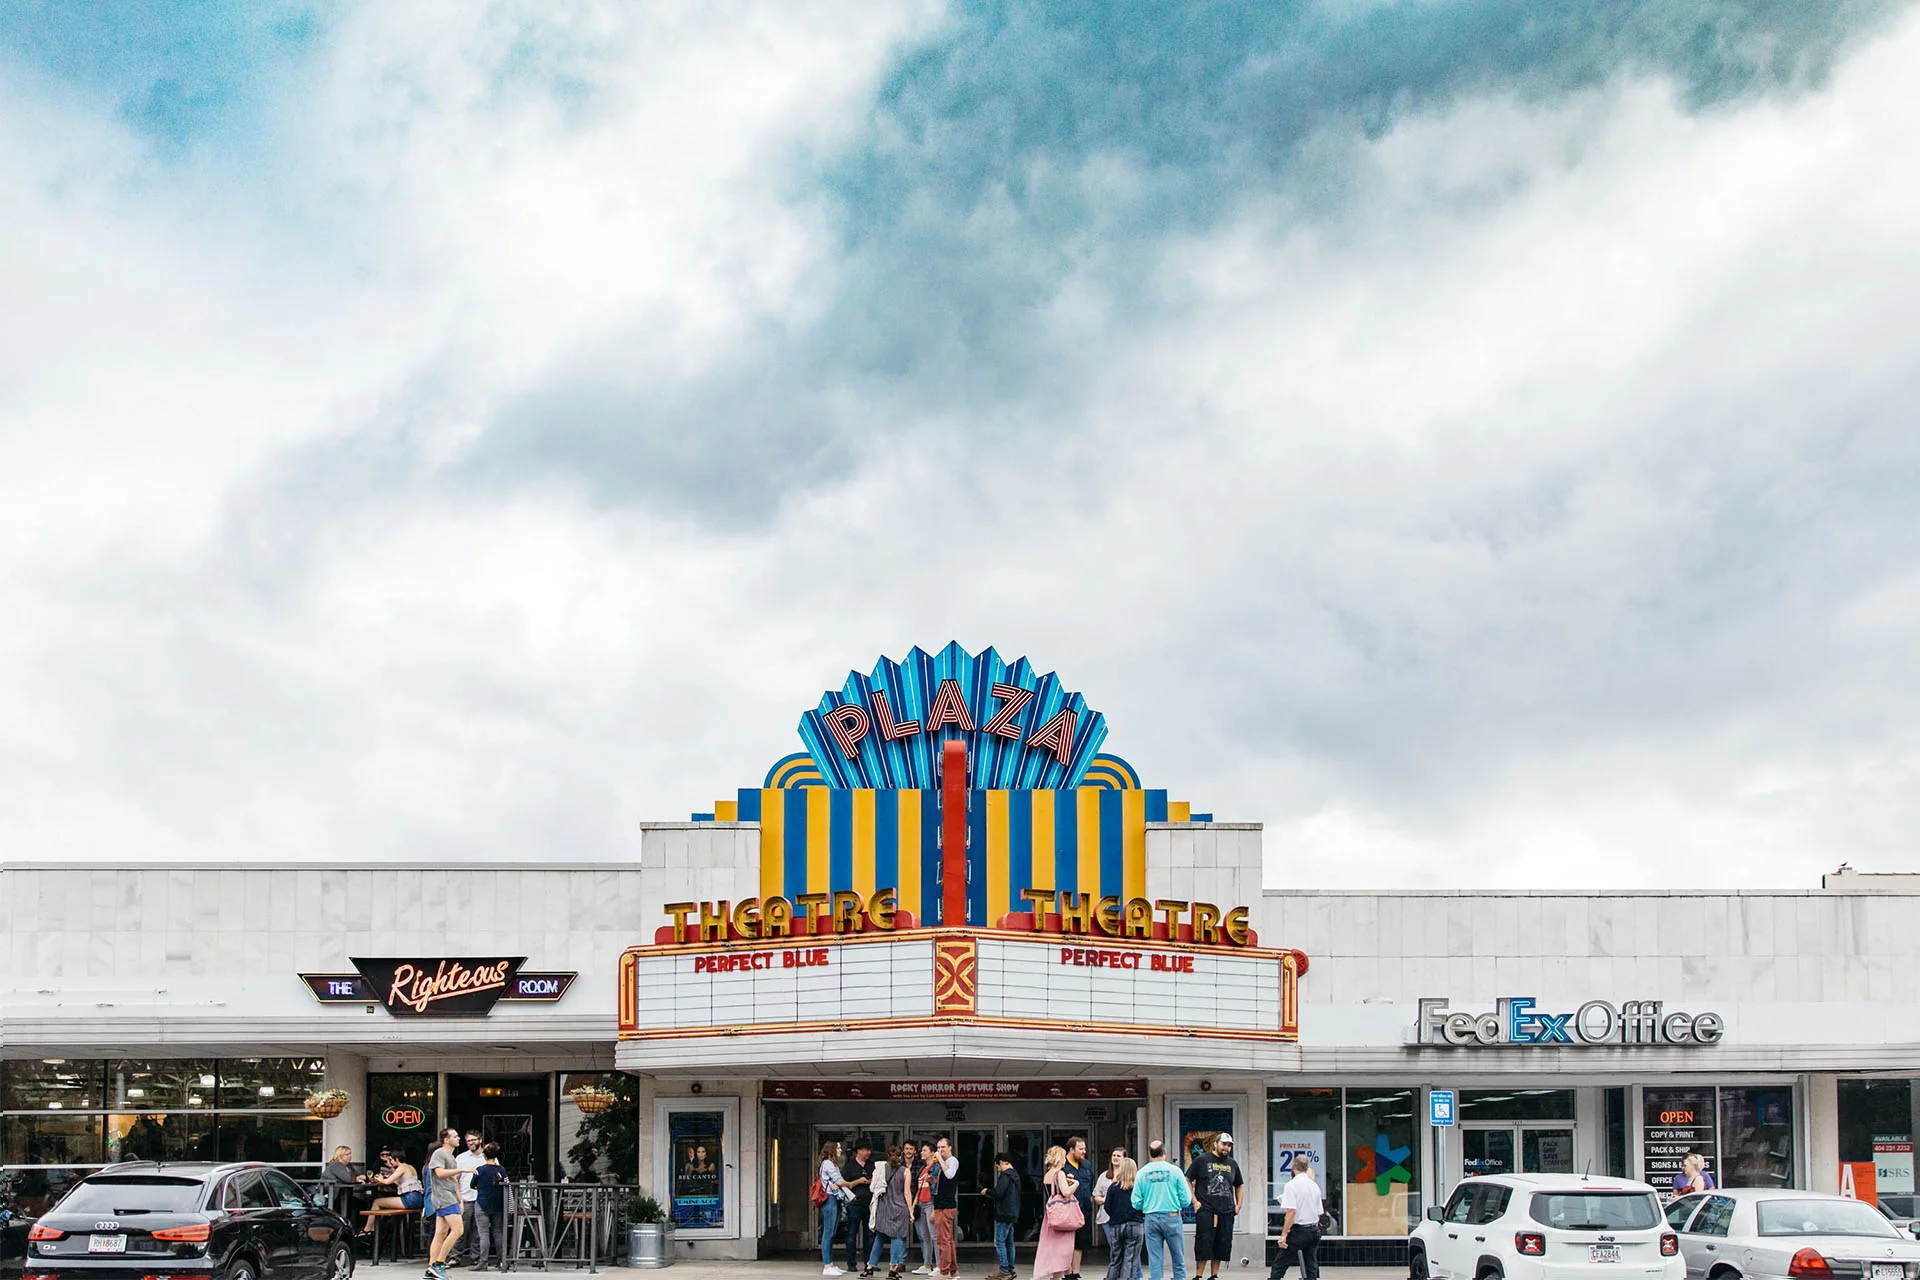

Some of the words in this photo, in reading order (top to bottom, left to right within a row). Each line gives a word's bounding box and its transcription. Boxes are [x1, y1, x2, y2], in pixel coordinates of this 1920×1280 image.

[823, 679, 1078, 767] PLAZA
[664, 887, 897, 943] THEATRE
[1020, 888, 1249, 945] THEATRE
[694, 952, 773, 973] PERFECT
[782, 948, 829, 968] BLUE
[1061, 948, 1143, 970] PERFECT
[1150, 953, 1194, 973] BLUE
[328, 981, 354, 995] THE
[388, 960, 510, 1013] Righteous
[518, 980, 558, 994] ROOM
[890, 1084, 918, 1093] ROCKY
[921, 1084, 955, 1093] HORROR
[958, 1084, 994, 1093] PICTURE
[996, 1084, 1019, 1093] SHOW
[385, 1111, 421, 1124] OPEN
[1660, 1111, 1694, 1123] OPEN
[1888, 1168, 1910, 1177] SRS
